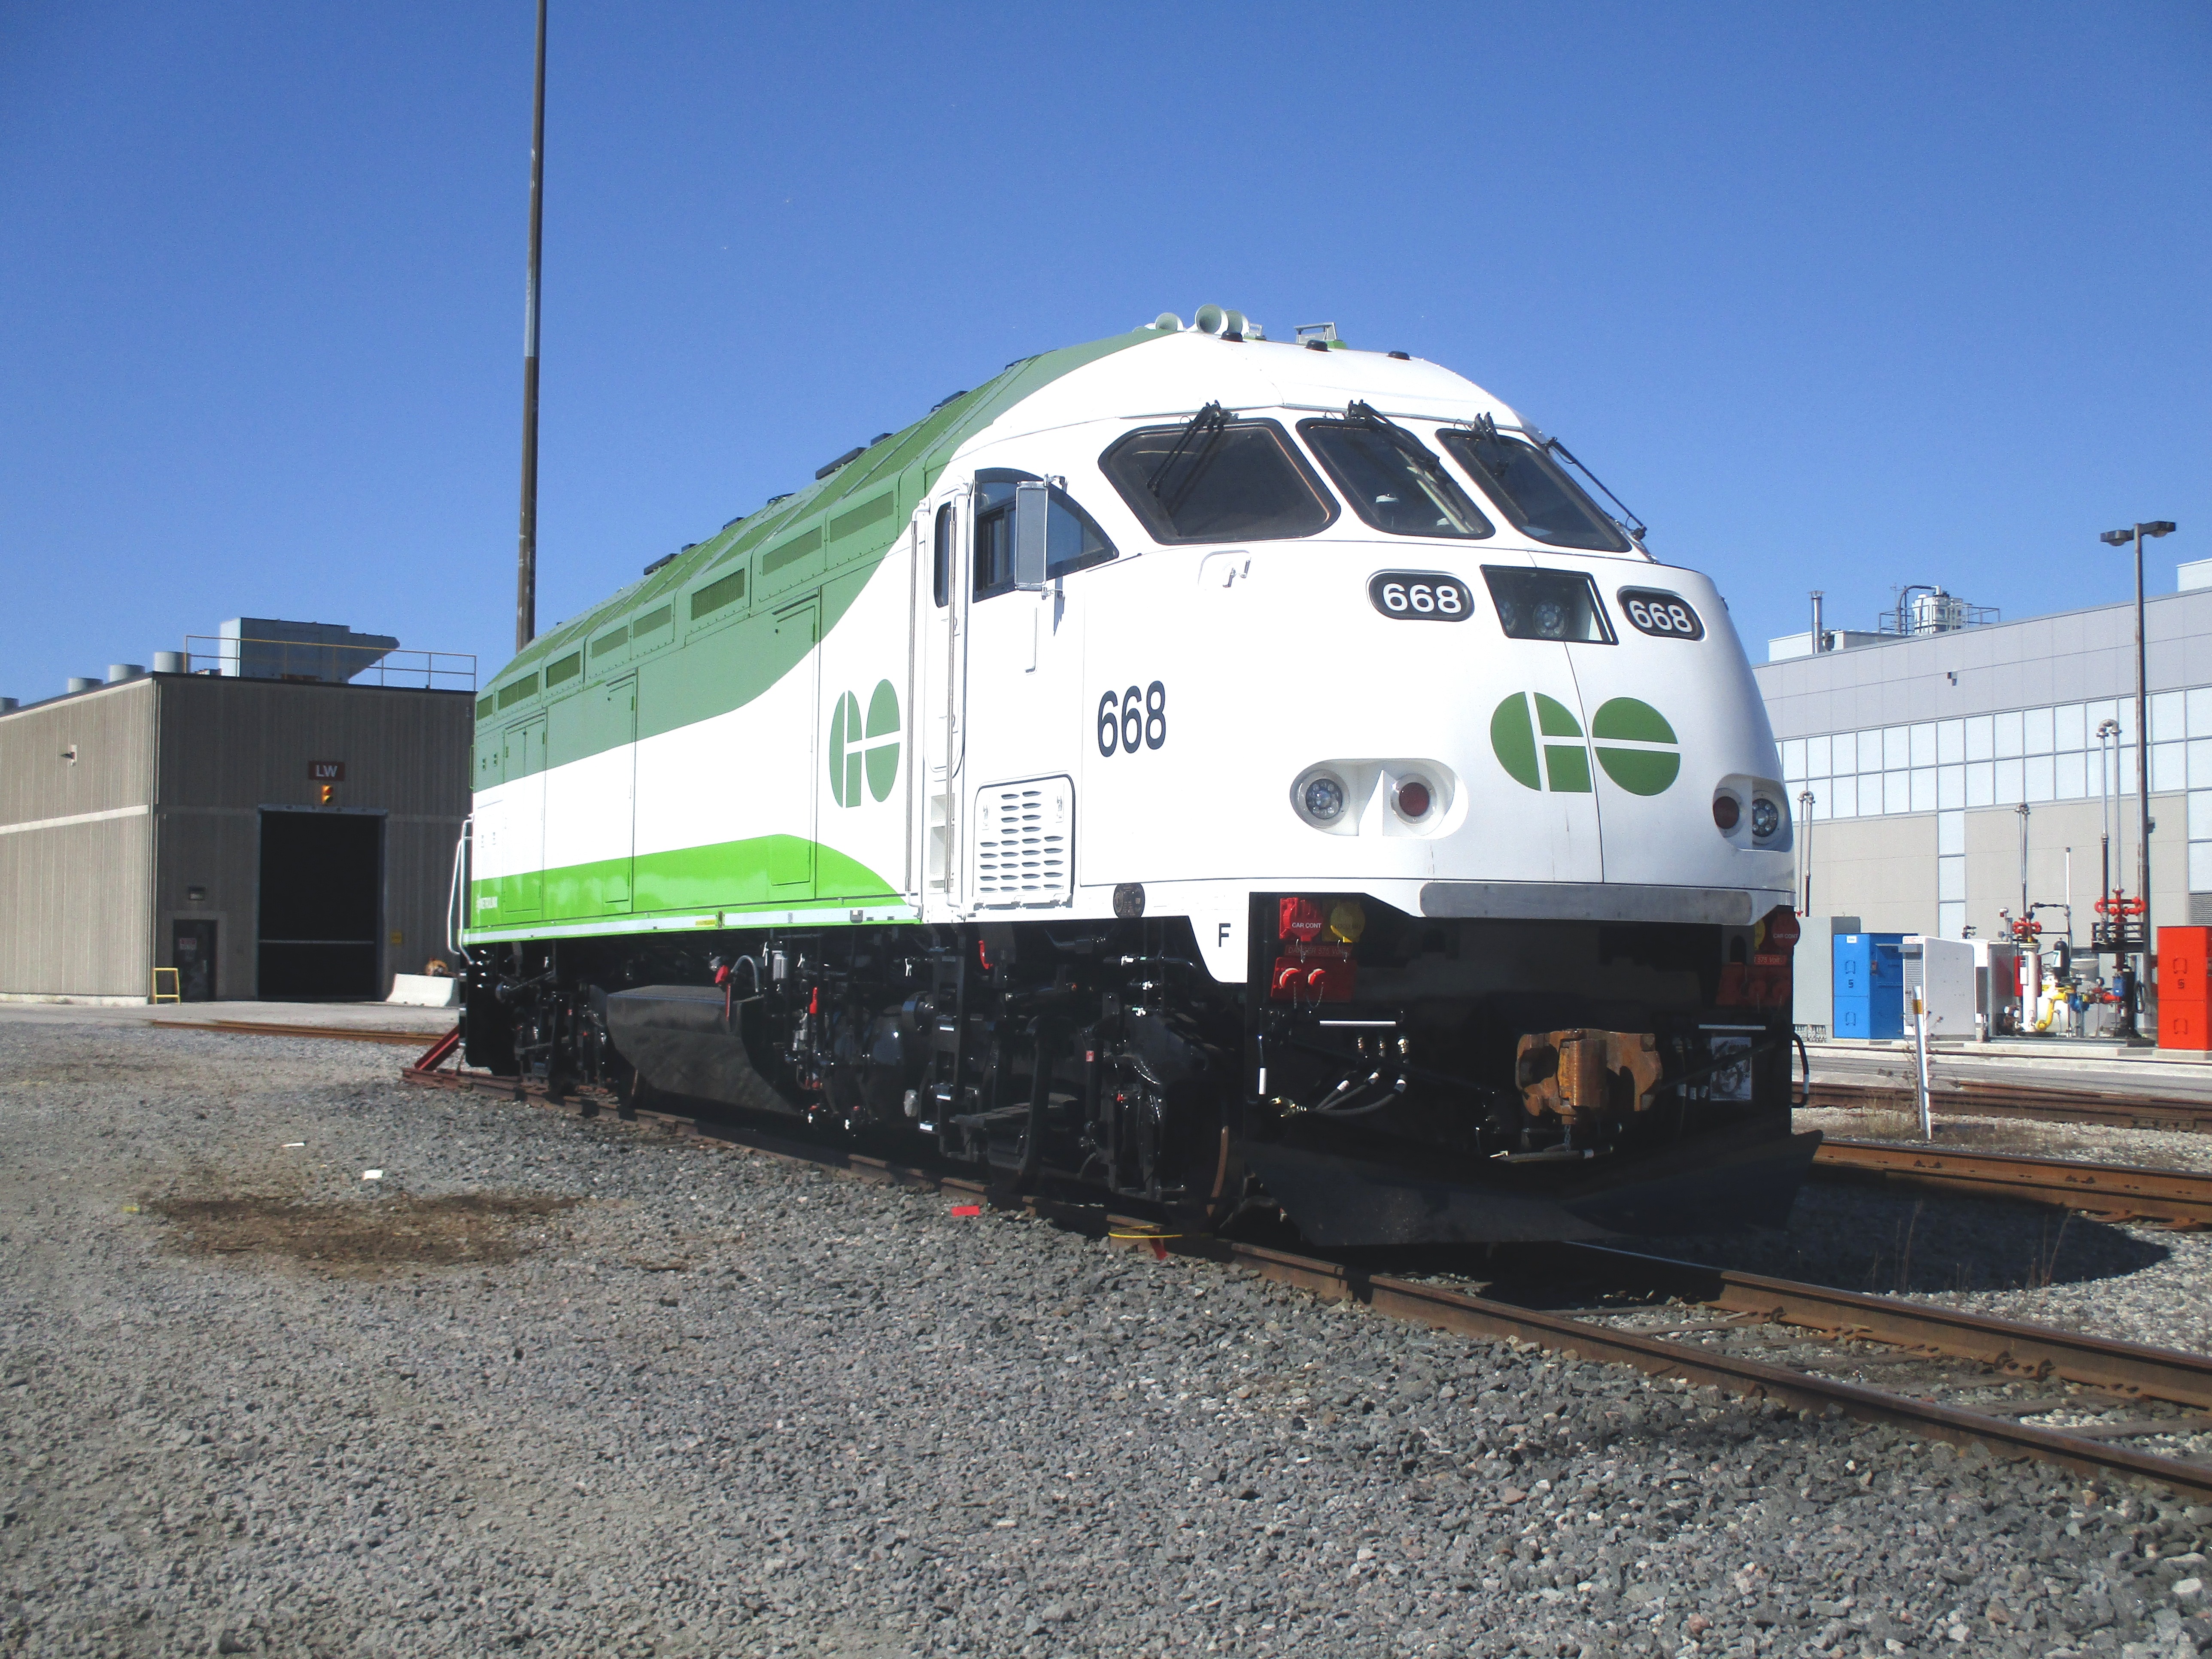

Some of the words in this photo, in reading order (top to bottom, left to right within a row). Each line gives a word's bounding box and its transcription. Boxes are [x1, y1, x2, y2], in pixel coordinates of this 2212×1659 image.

[1383, 583, 1462, 614] 668
[1629, 600, 1692, 633] 668
[1097, 681, 1166, 757] 668
[316, 765, 337, 777] LW
[1218, 923, 1231, 948] F
